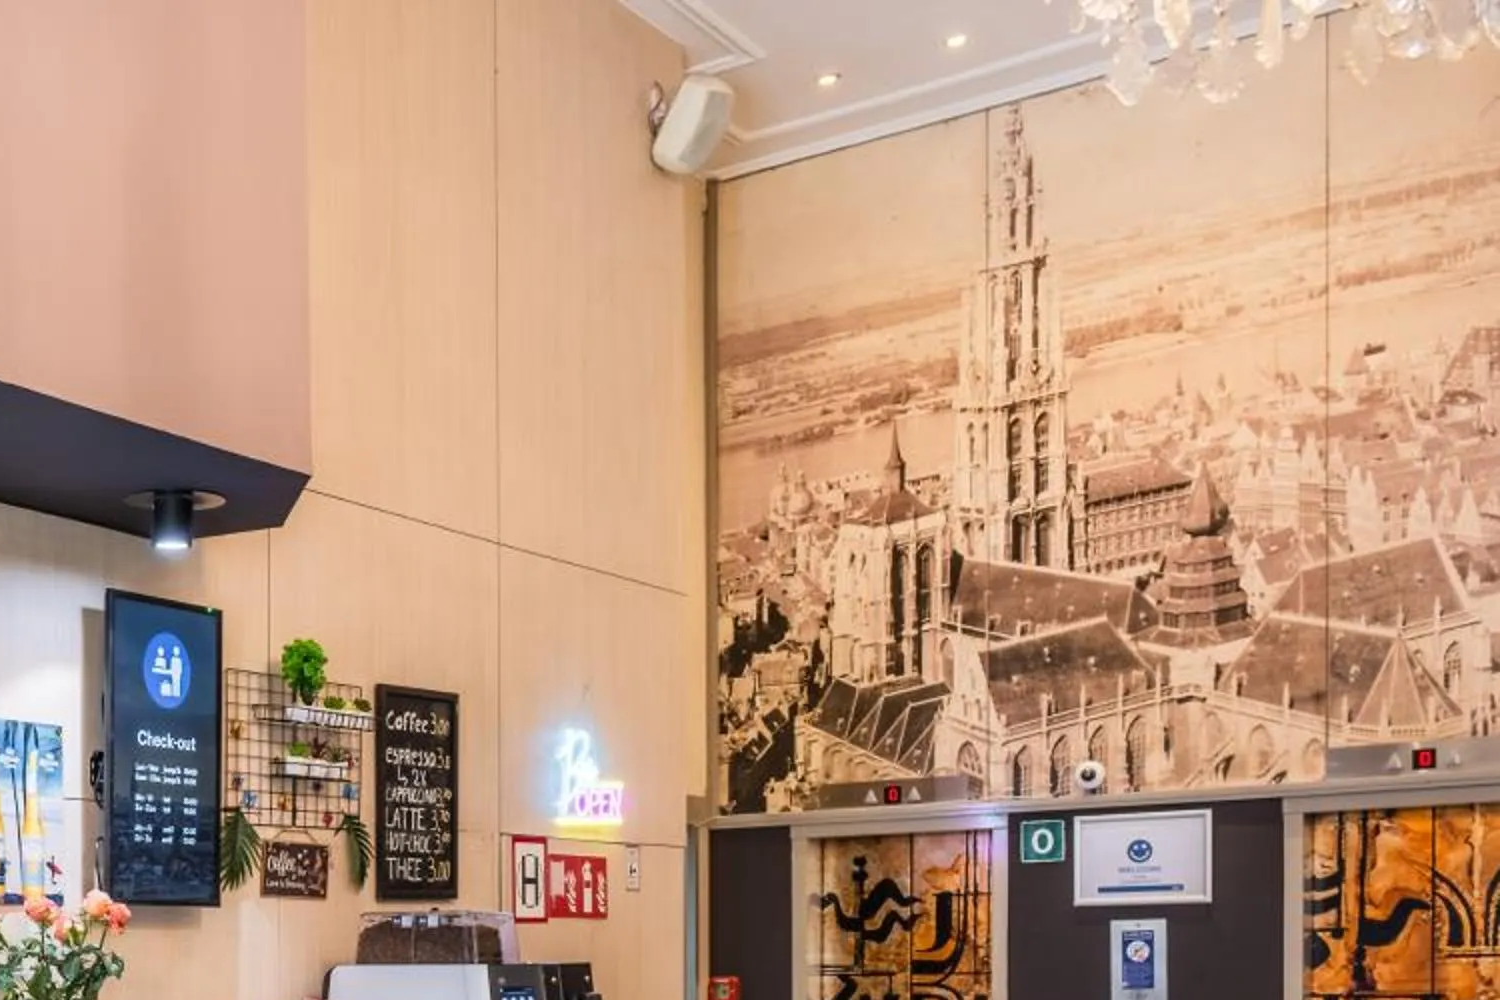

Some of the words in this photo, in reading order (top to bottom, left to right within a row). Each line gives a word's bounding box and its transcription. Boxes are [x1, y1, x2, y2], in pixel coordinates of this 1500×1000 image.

[385, 709, 428, 733] Coffee
[137, 729, 197, 752] Check-out
[573, 787, 623, 818] OPEN
[385, 806, 427, 831] LATTE
[385, 857, 423, 881] THEE
